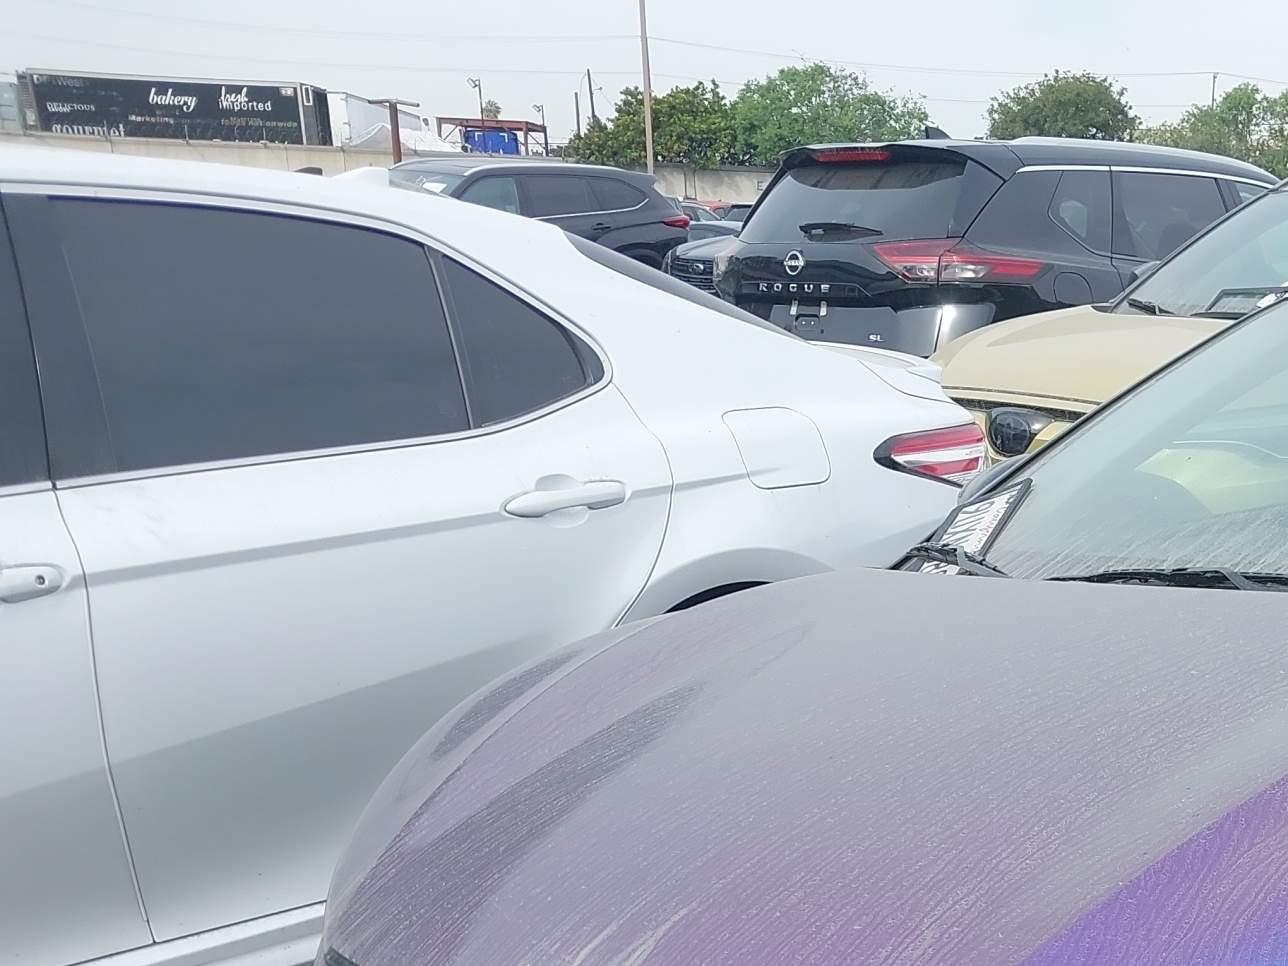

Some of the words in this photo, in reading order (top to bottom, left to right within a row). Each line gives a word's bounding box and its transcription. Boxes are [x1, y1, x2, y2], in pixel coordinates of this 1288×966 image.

[149, 87, 197, 112] bakery
[219, 85, 248, 102] fresh
[218, 98, 272, 112] imported
[759, 283, 831, 293] ROGUE
[868, 333, 886, 342] SL
